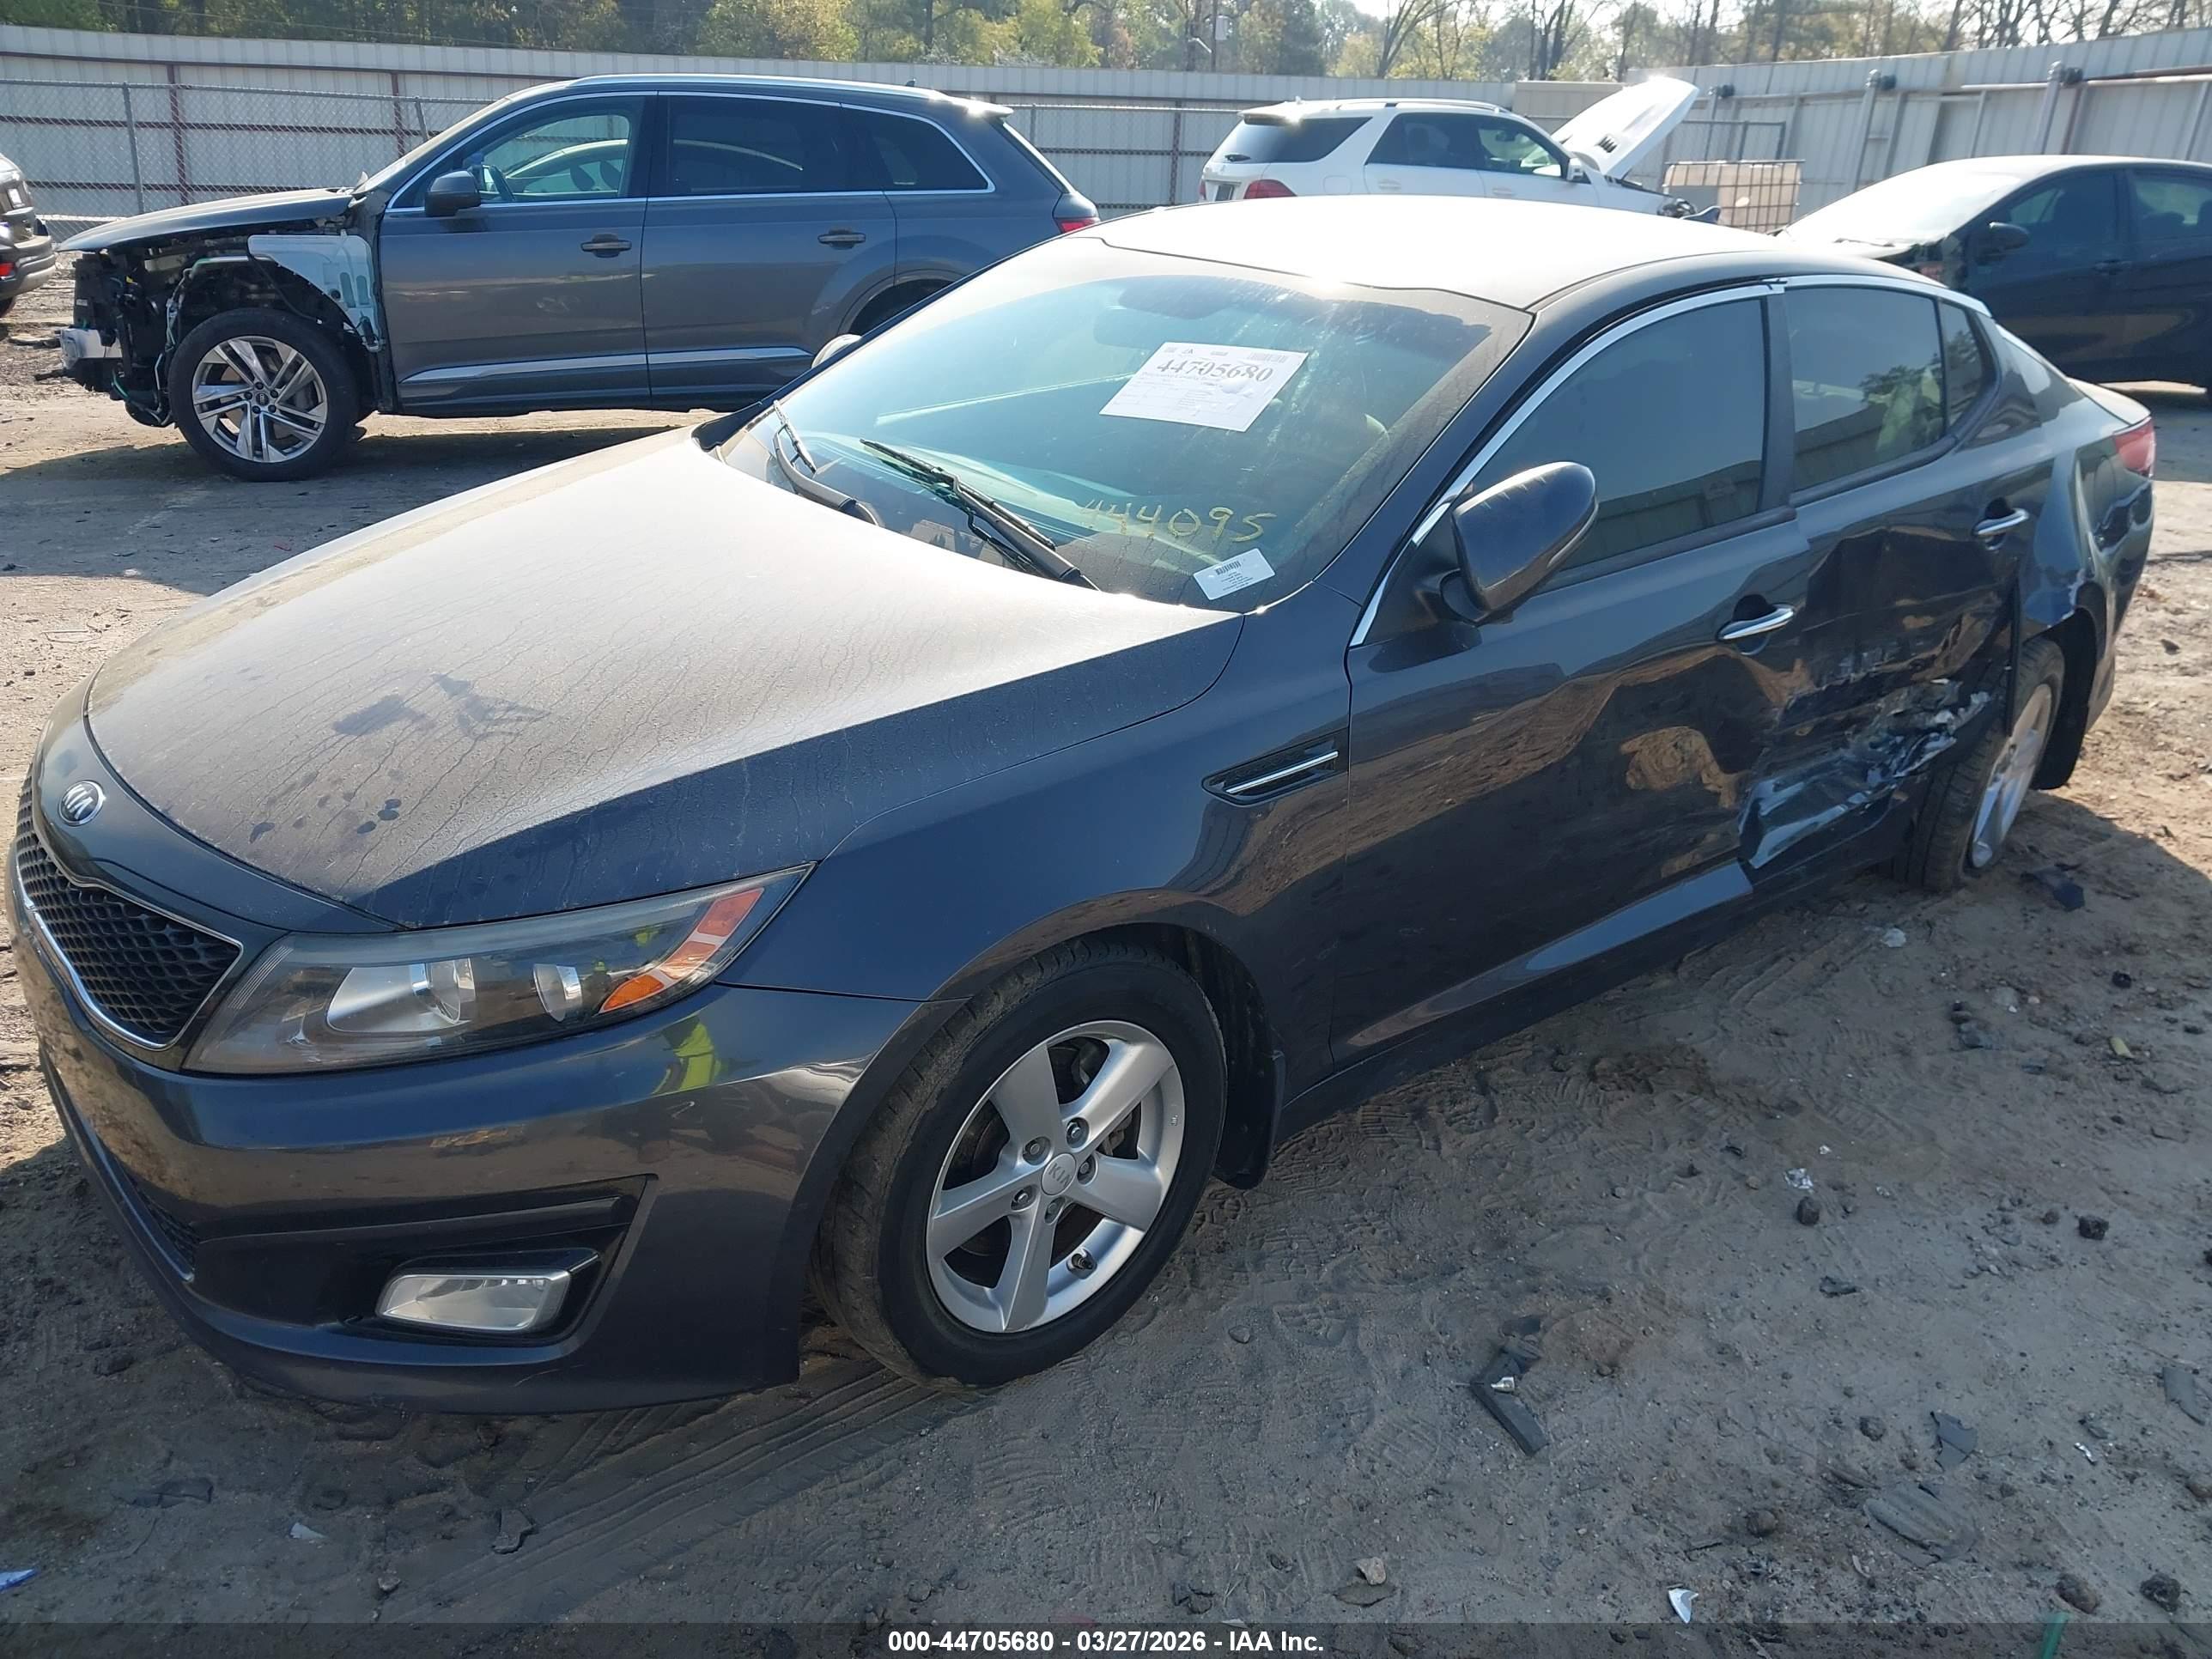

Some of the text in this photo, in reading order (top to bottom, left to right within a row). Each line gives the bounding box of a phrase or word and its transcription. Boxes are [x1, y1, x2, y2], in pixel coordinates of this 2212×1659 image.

[1157, 359, 1273, 382] 44705680
[62, 783, 94, 820] KIA
[1048, 1162, 1072, 1188] KIA
